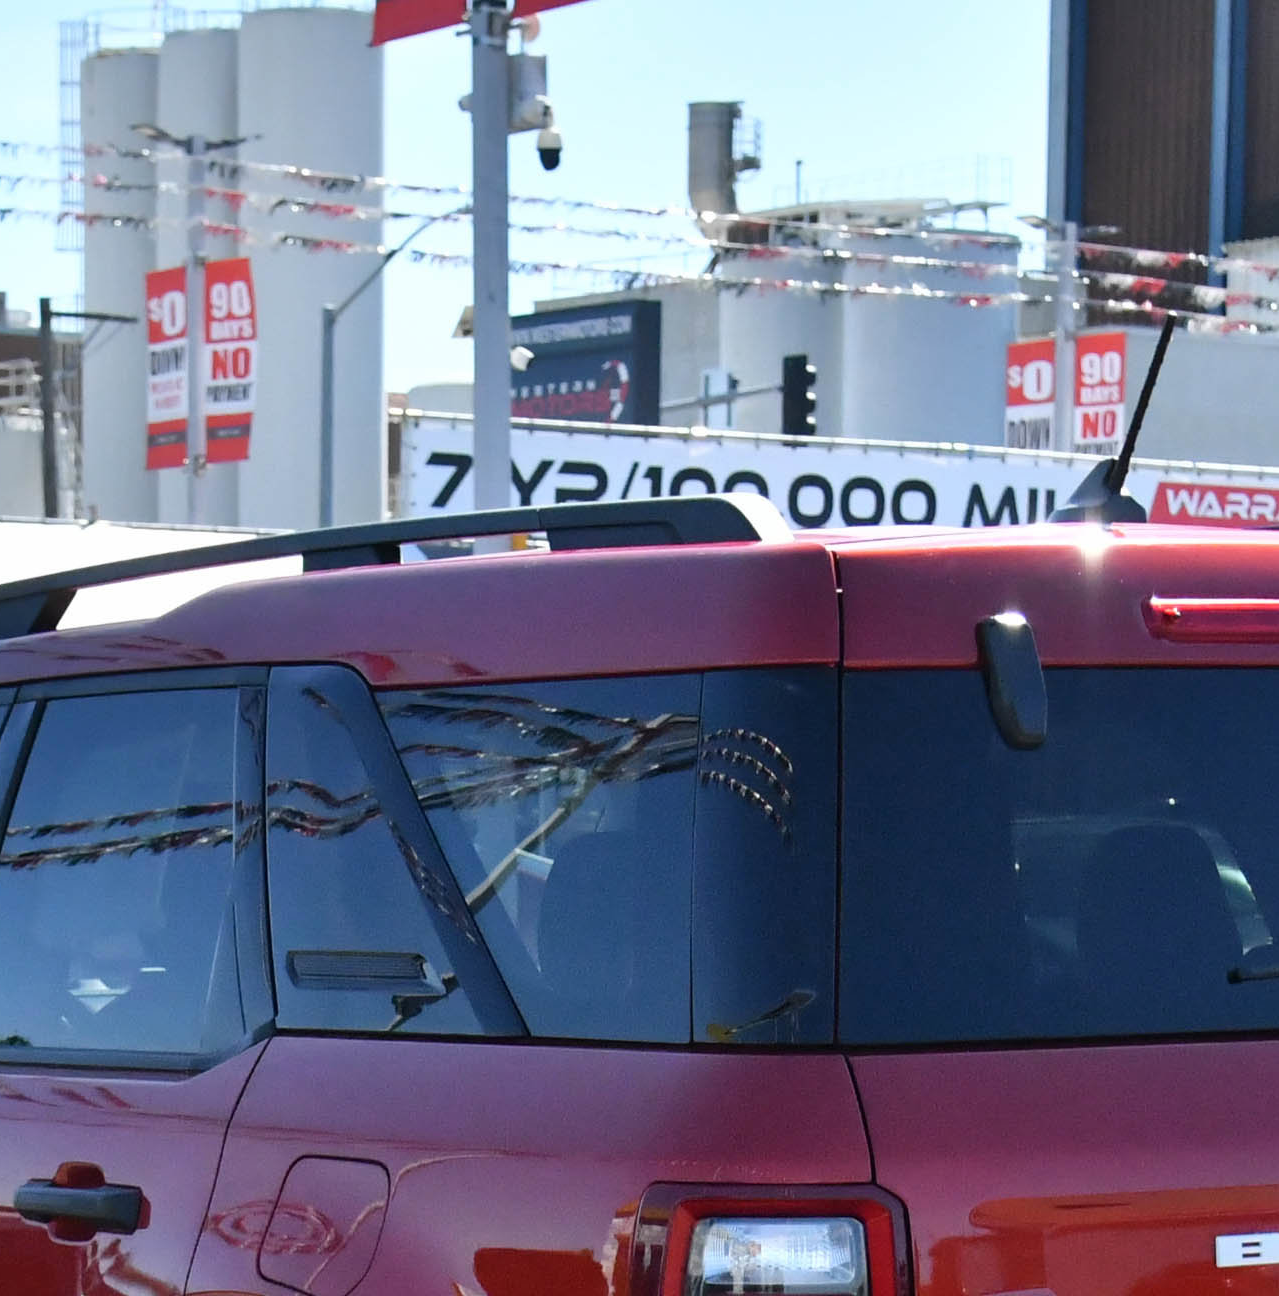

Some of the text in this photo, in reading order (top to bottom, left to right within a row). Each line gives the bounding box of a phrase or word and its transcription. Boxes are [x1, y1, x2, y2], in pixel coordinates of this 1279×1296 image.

[148, 290, 187, 338] $0
[210, 280, 252, 320] 90
[210, 319, 254, 341] DAYS
[211, 347, 251, 381] NO
[1008, 359, 1054, 401] $0
[1080, 351, 1122, 386] 90
[1080, 385, 1121, 404] DAYS
[1008, 418, 1051, 449] DOWN
[1082, 410, 1116, 440] NO
[425, 452, 474, 508] 7
